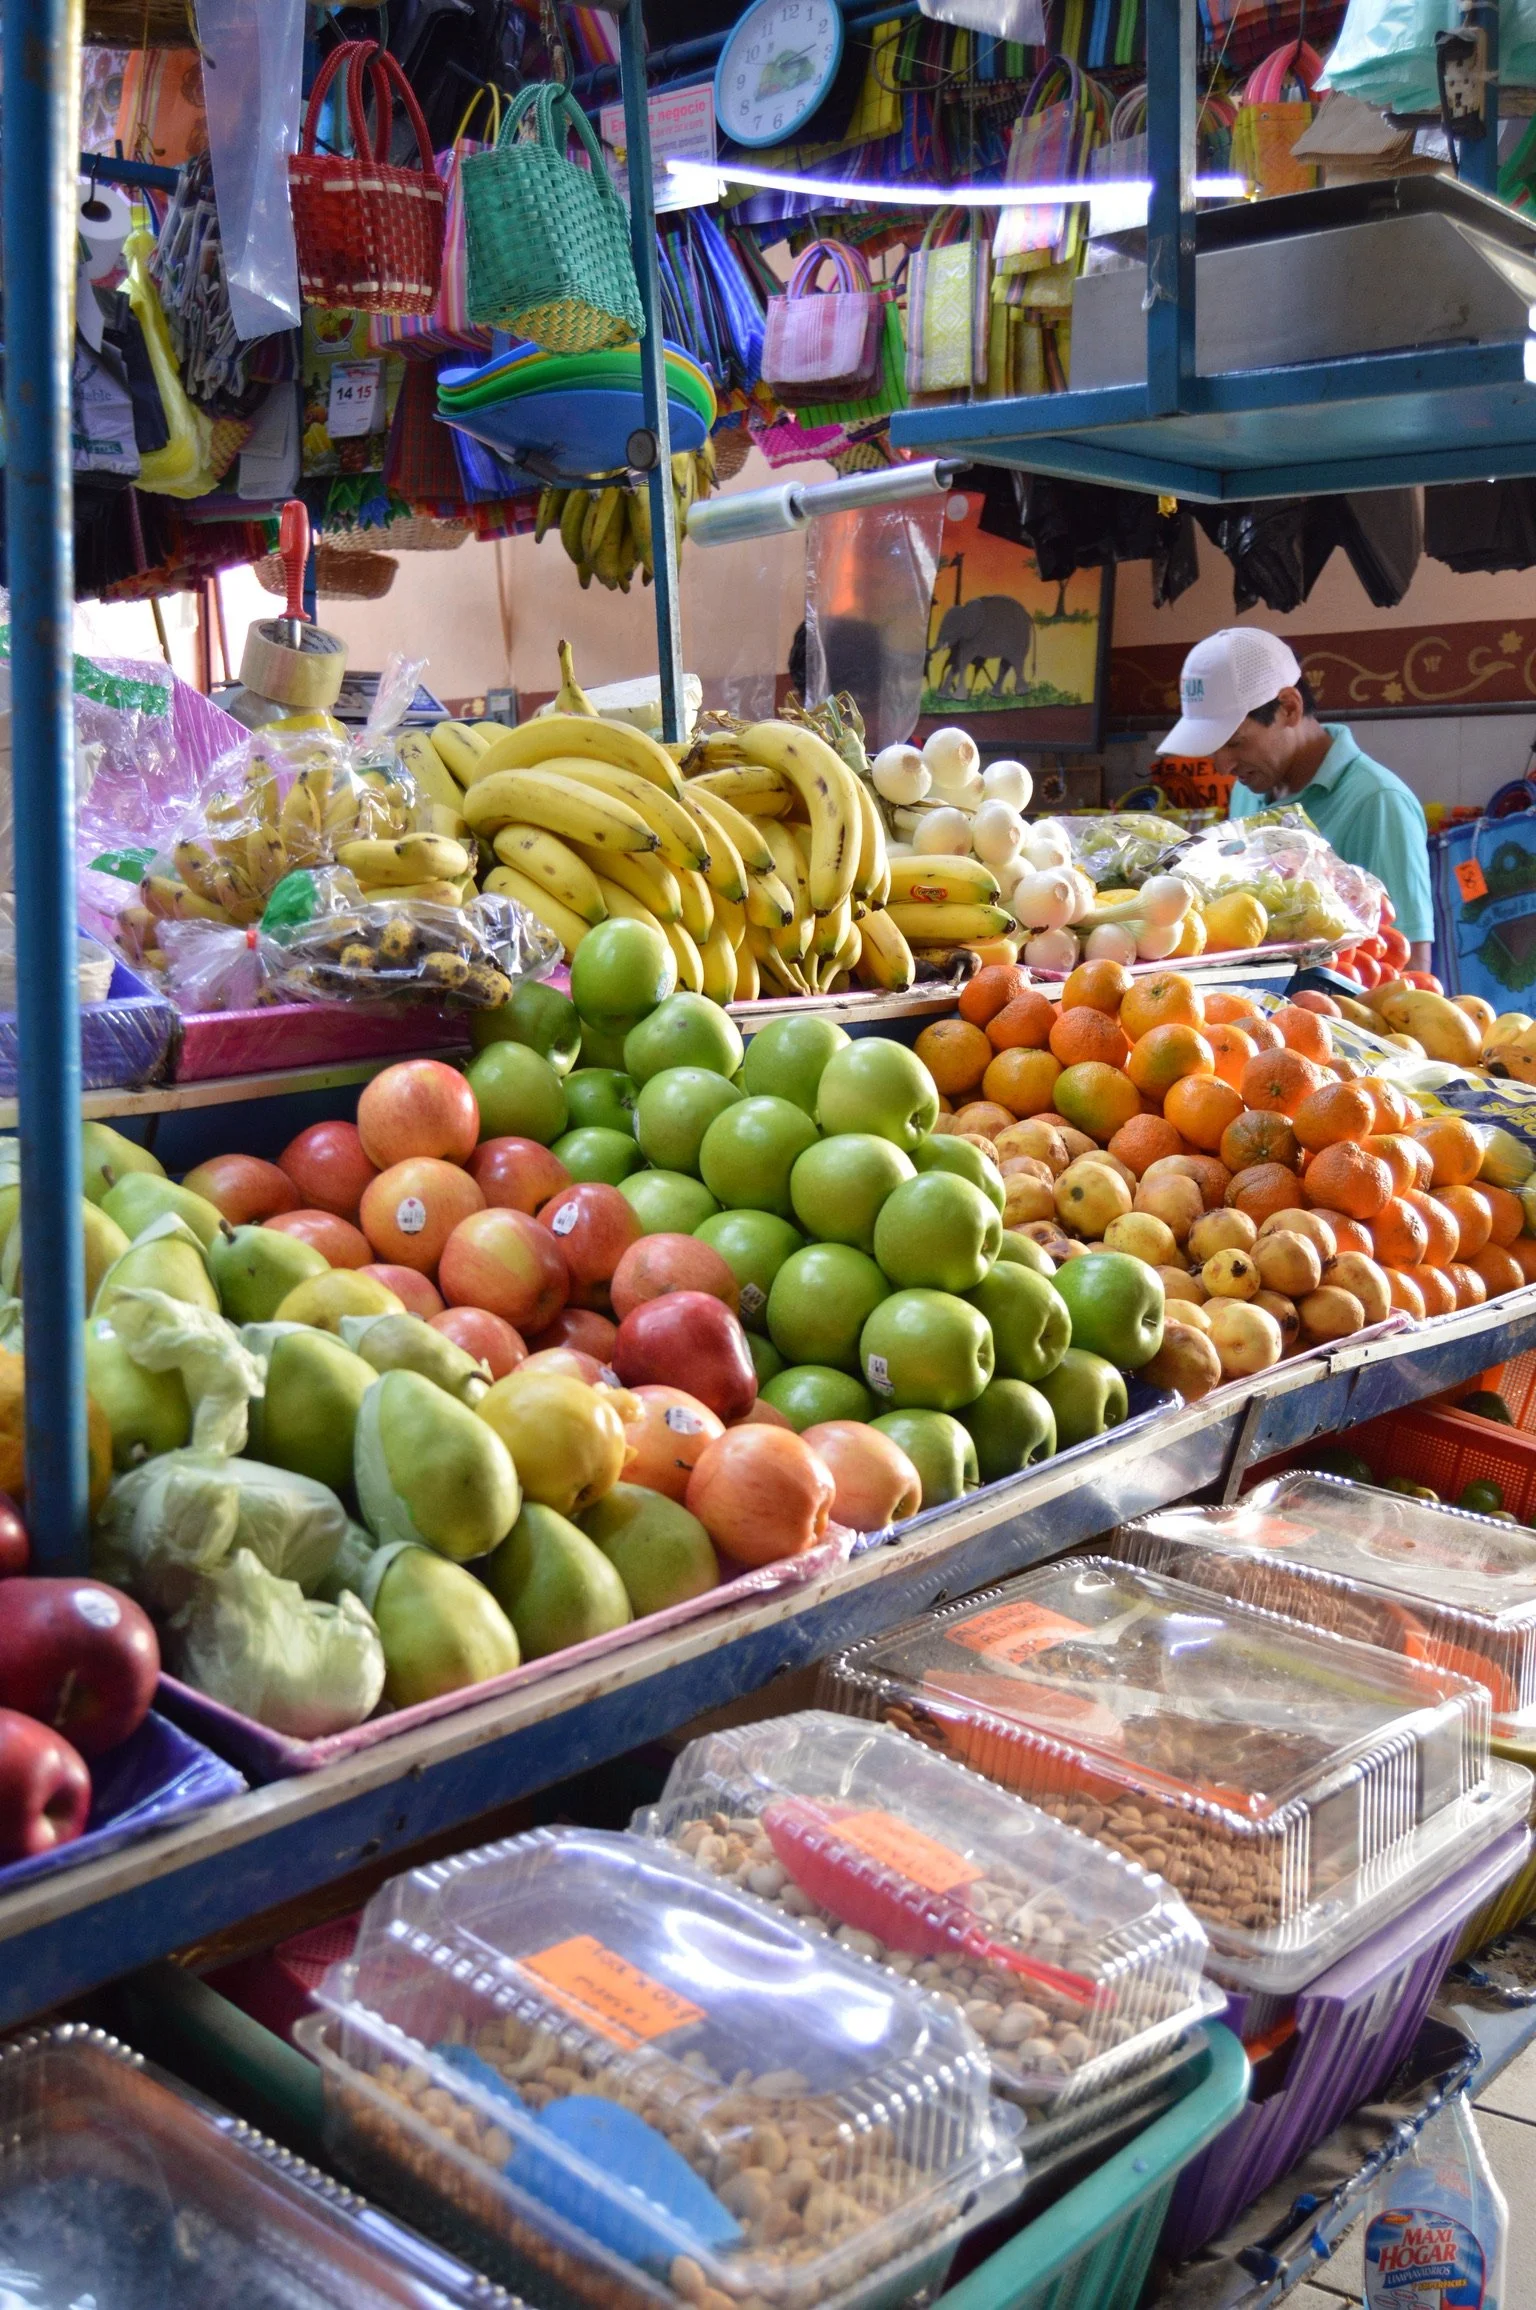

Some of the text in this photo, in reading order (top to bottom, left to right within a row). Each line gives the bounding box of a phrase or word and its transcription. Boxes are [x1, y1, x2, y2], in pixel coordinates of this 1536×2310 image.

[782, 3, 800, 21] 12
[807, 6, 814, 21] 1
[762, 20, 774, 38] 11
[818, 18, 828, 34] 2
[744, 45, 760, 63] 10
[824, 44, 832, 61] 3
[737, 74, 746, 91] 9
[658, 100, 706, 122] negocio
[740, 99, 750, 115] 8
[795, 98, 805, 113] 5
[753, 115, 762, 130] 7
[773, 113, 783, 129] 6
[336, 385, 372, 400] 14 15
[1402, 2227, 1455, 2248] MAXI
[1378, 2243, 1457, 2272] HOGAR
